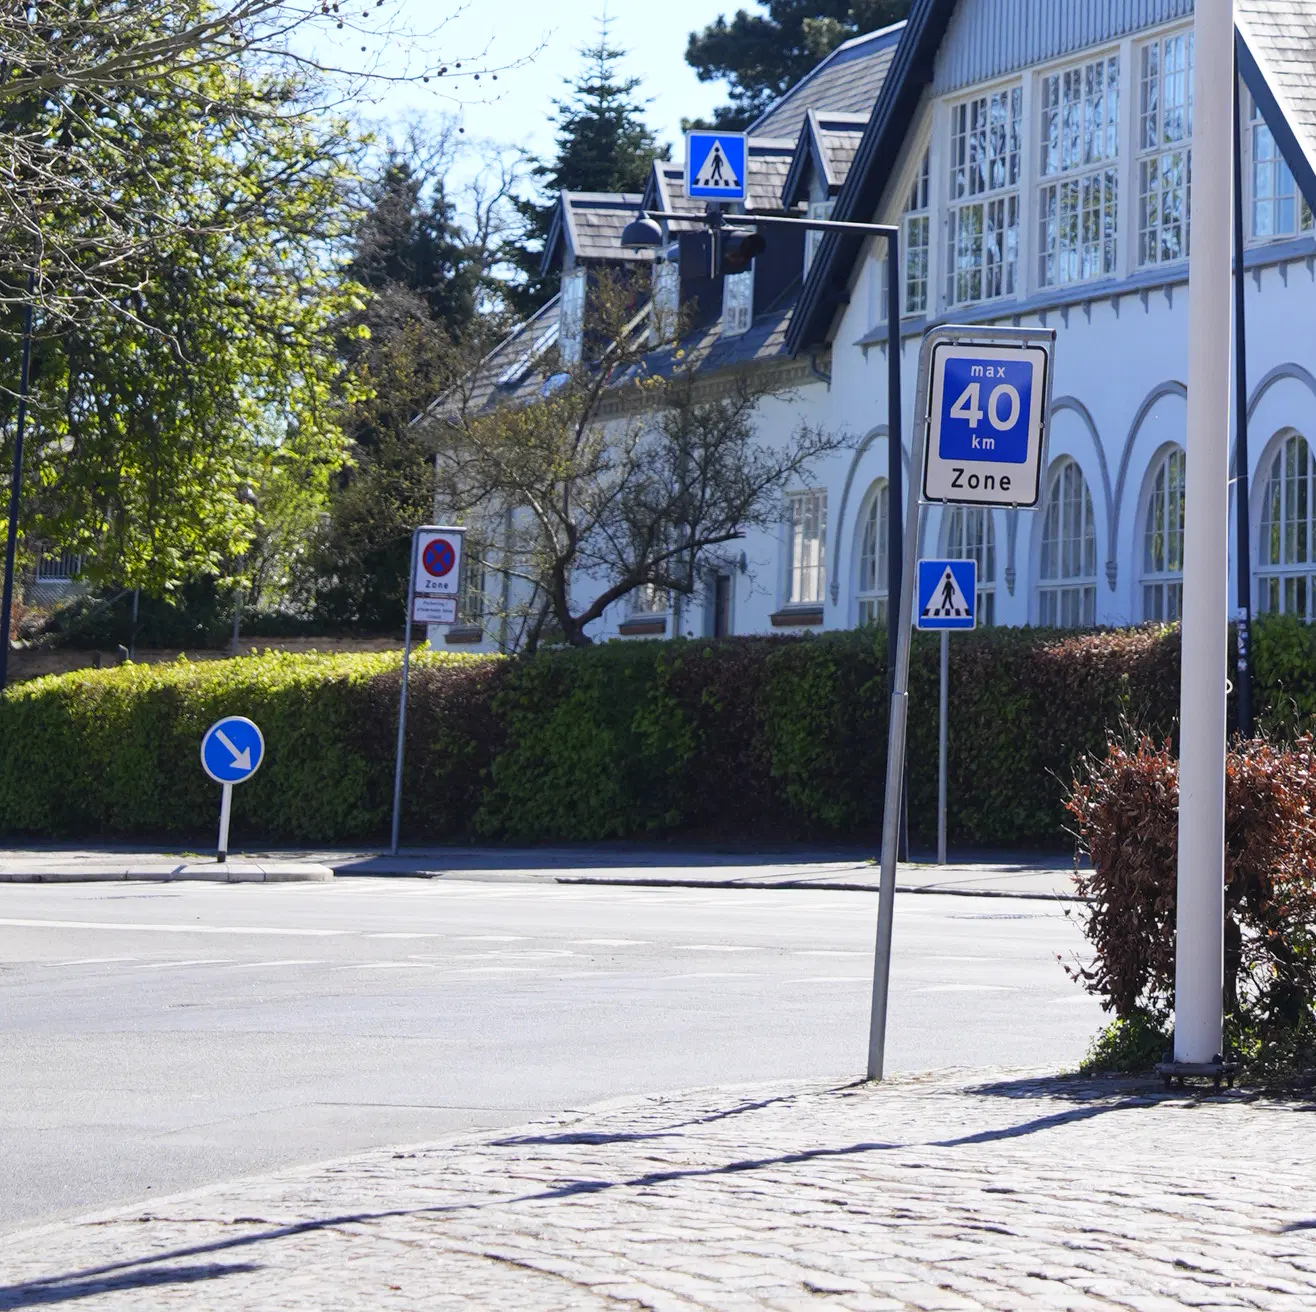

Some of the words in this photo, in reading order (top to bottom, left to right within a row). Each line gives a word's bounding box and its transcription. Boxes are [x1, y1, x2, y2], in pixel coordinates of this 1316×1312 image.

[970, 364, 1006, 378] max
[950, 381, 1021, 431] 40
[971, 434, 996, 450] km
[951, 467, 1012, 492] Zone
[425, 579, 449, 589] Zone
